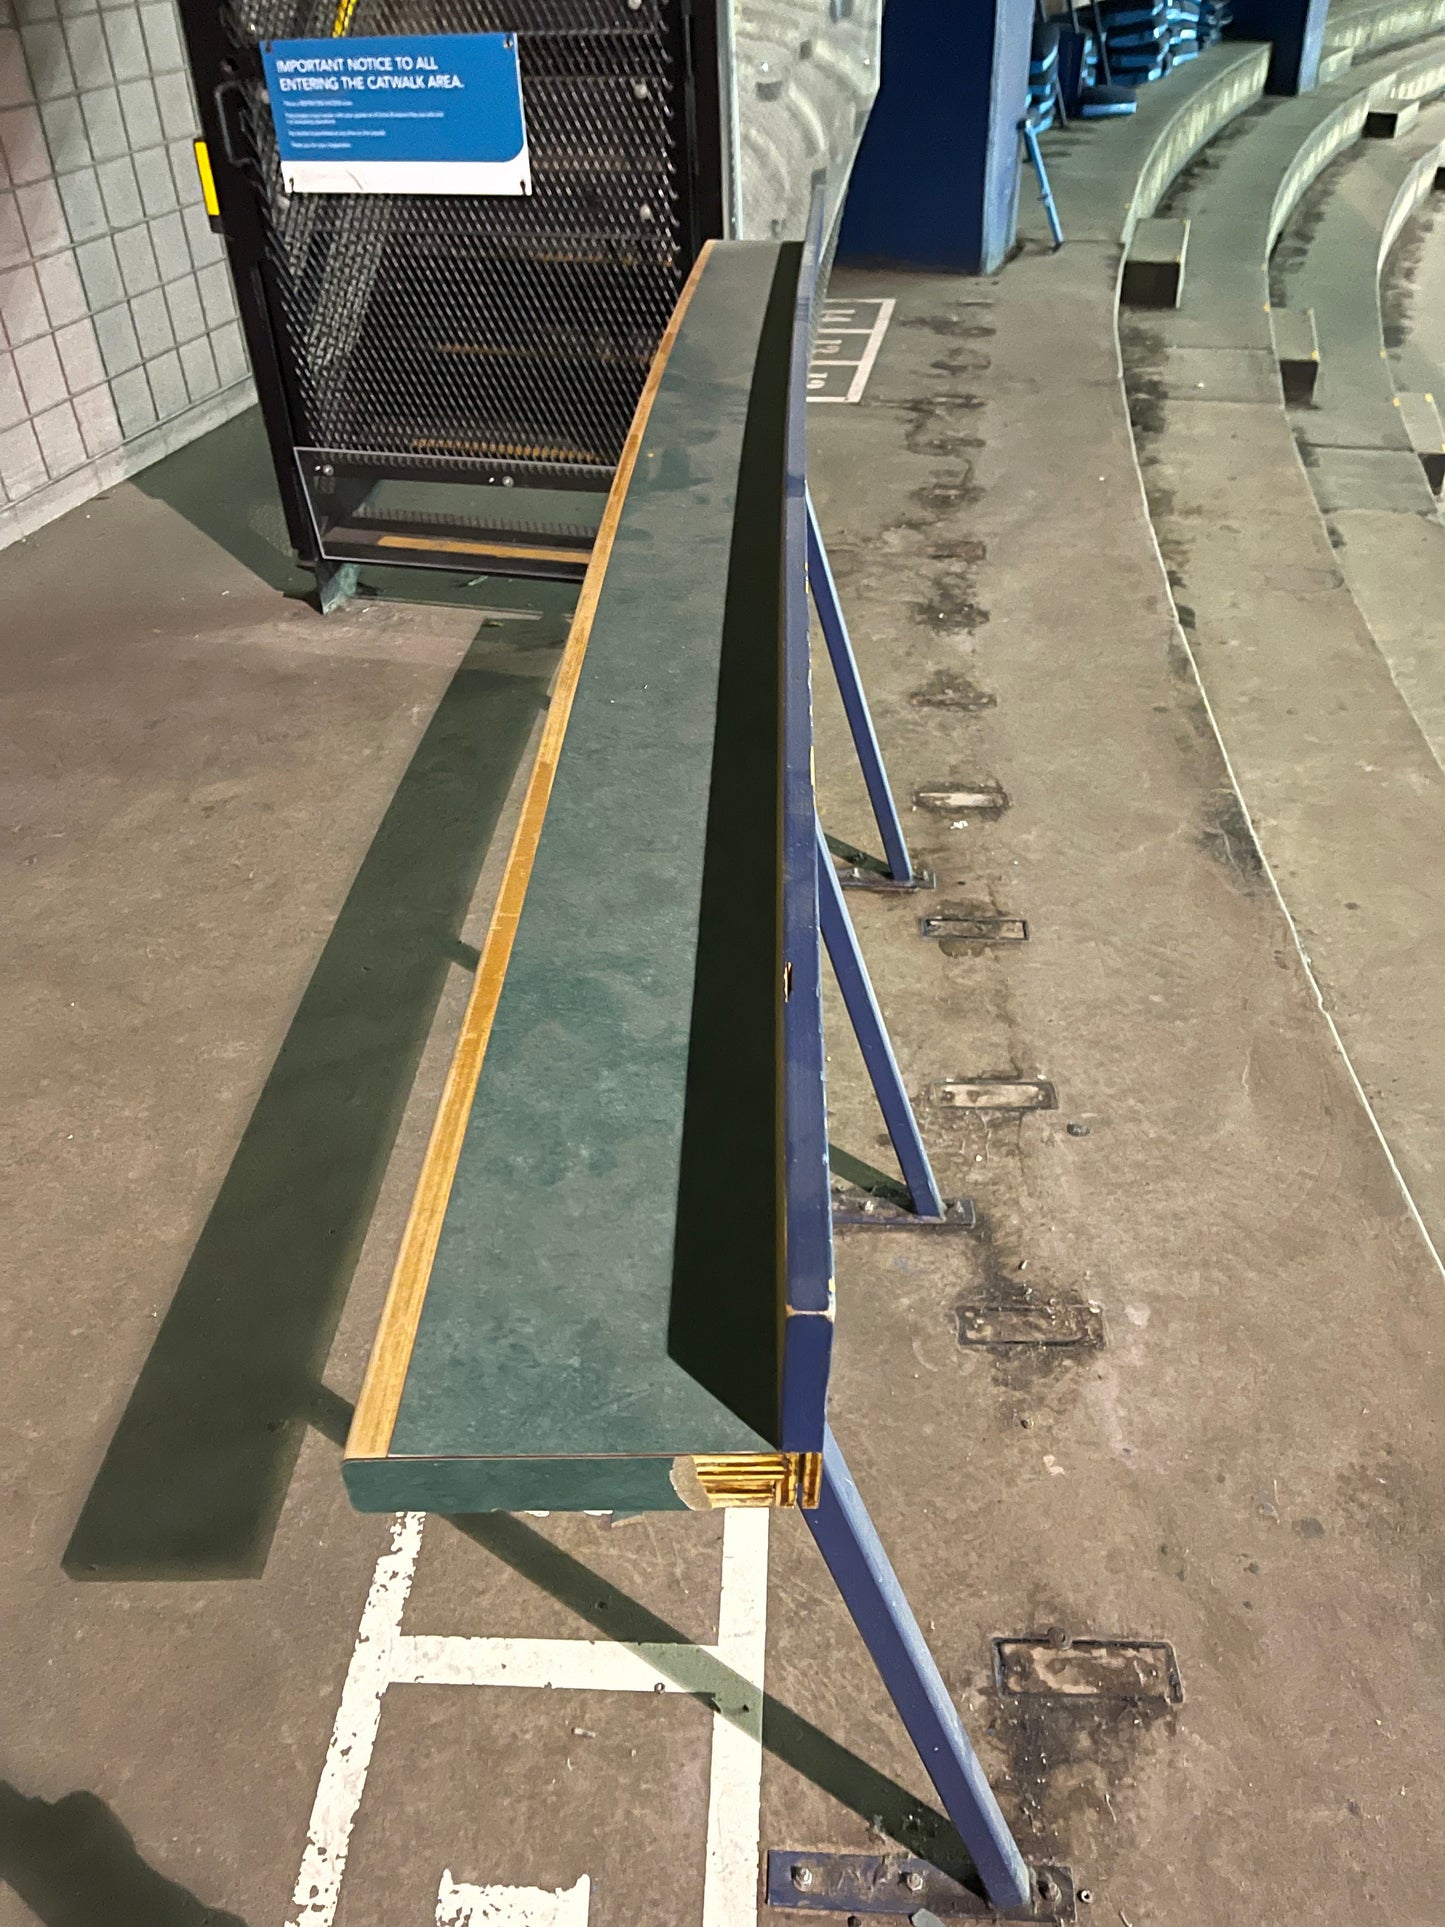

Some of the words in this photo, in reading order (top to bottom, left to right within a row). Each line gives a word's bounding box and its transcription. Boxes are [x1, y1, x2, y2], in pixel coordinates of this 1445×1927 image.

[276, 58, 343, 73] IMPORTANT
[347, 57, 393, 72] NOTICE
[395, 56, 413, 71] TO
[416, 56, 438, 70] ALL
[279, 77, 338, 91] ENTERING
[341, 76, 365, 90] THE
[367, 75, 425, 90] CATWALK
[428, 75, 464, 89] AREA.
